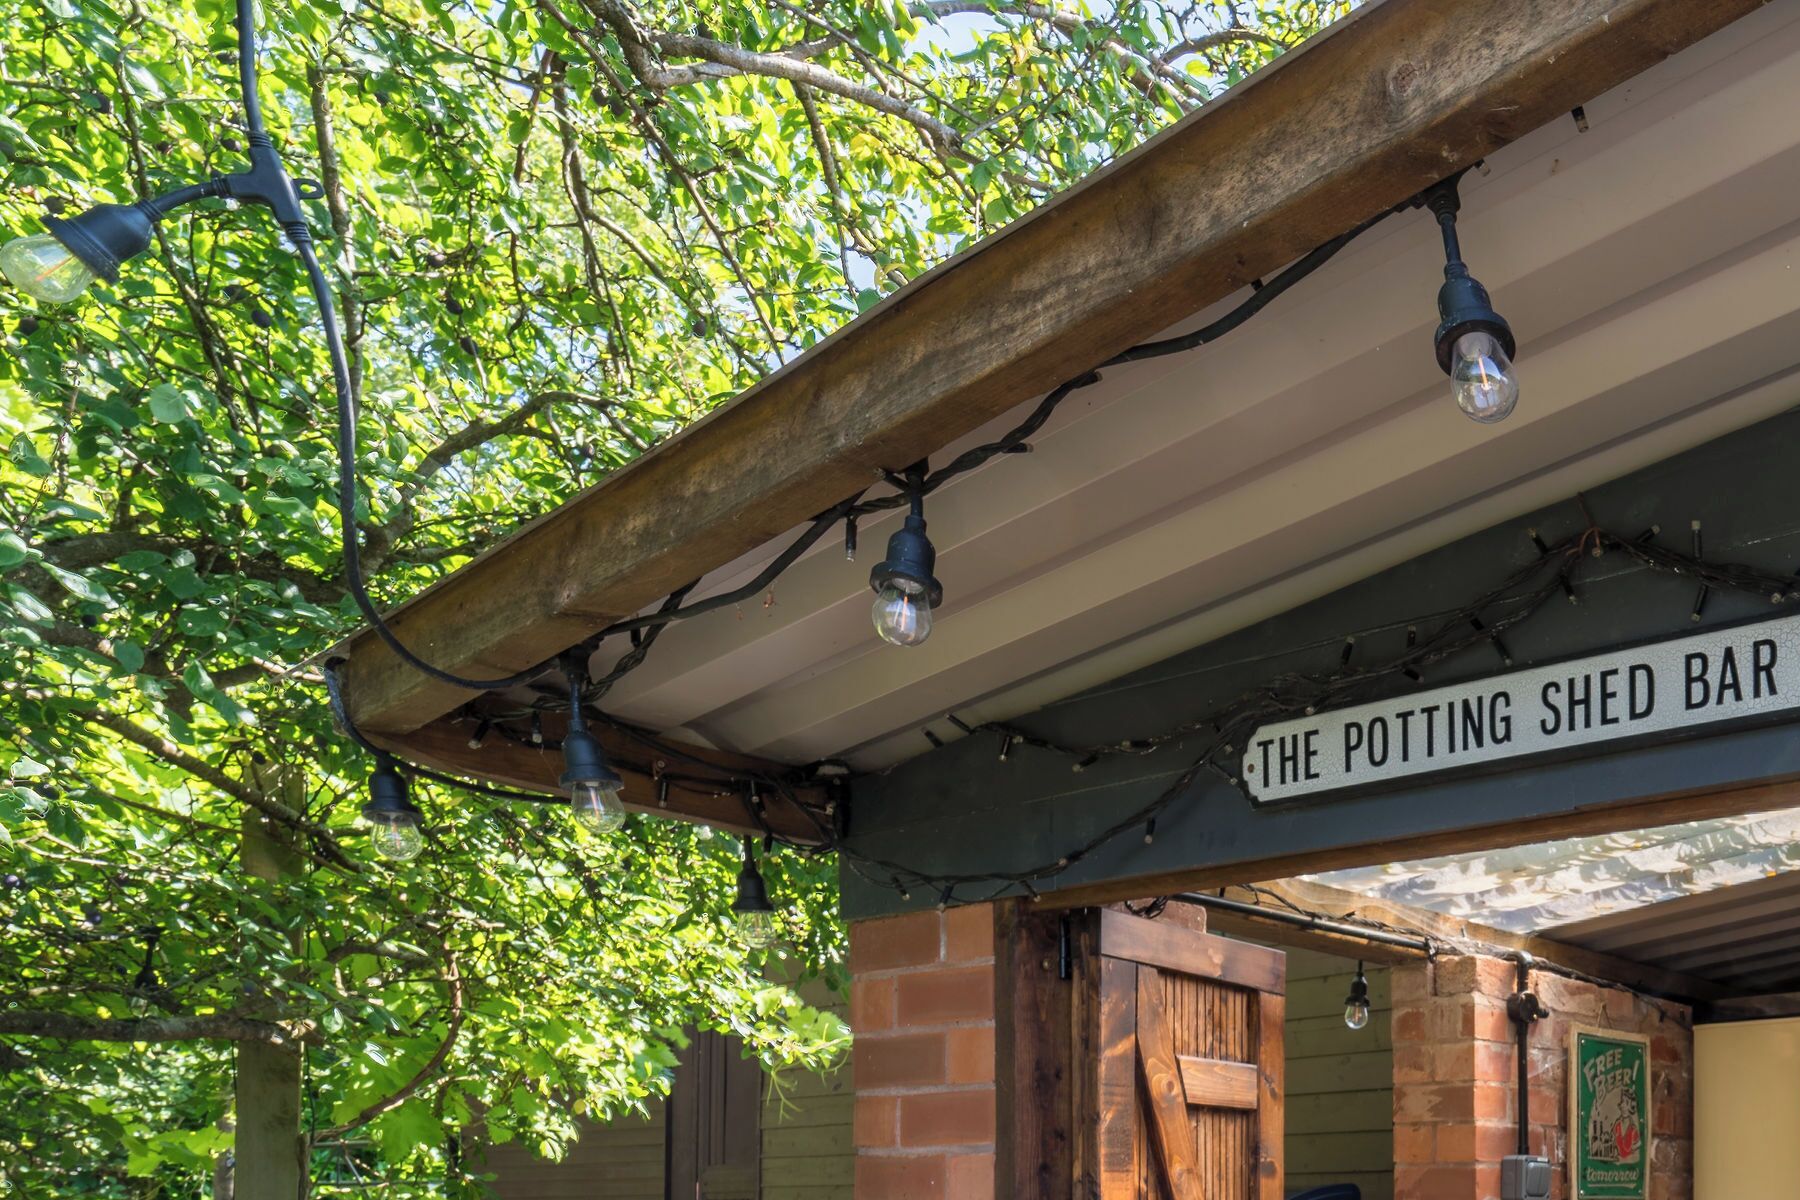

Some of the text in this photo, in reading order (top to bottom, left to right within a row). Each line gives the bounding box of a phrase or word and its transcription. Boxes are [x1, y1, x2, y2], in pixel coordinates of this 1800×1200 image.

[1257, 639, 1778, 788] THE POTTING SHED BAR
[1583, 1048, 1623, 1093] FREE
[1593, 1060, 1640, 1102] BEER!
[1587, 1166, 1639, 1181] tomorrow
